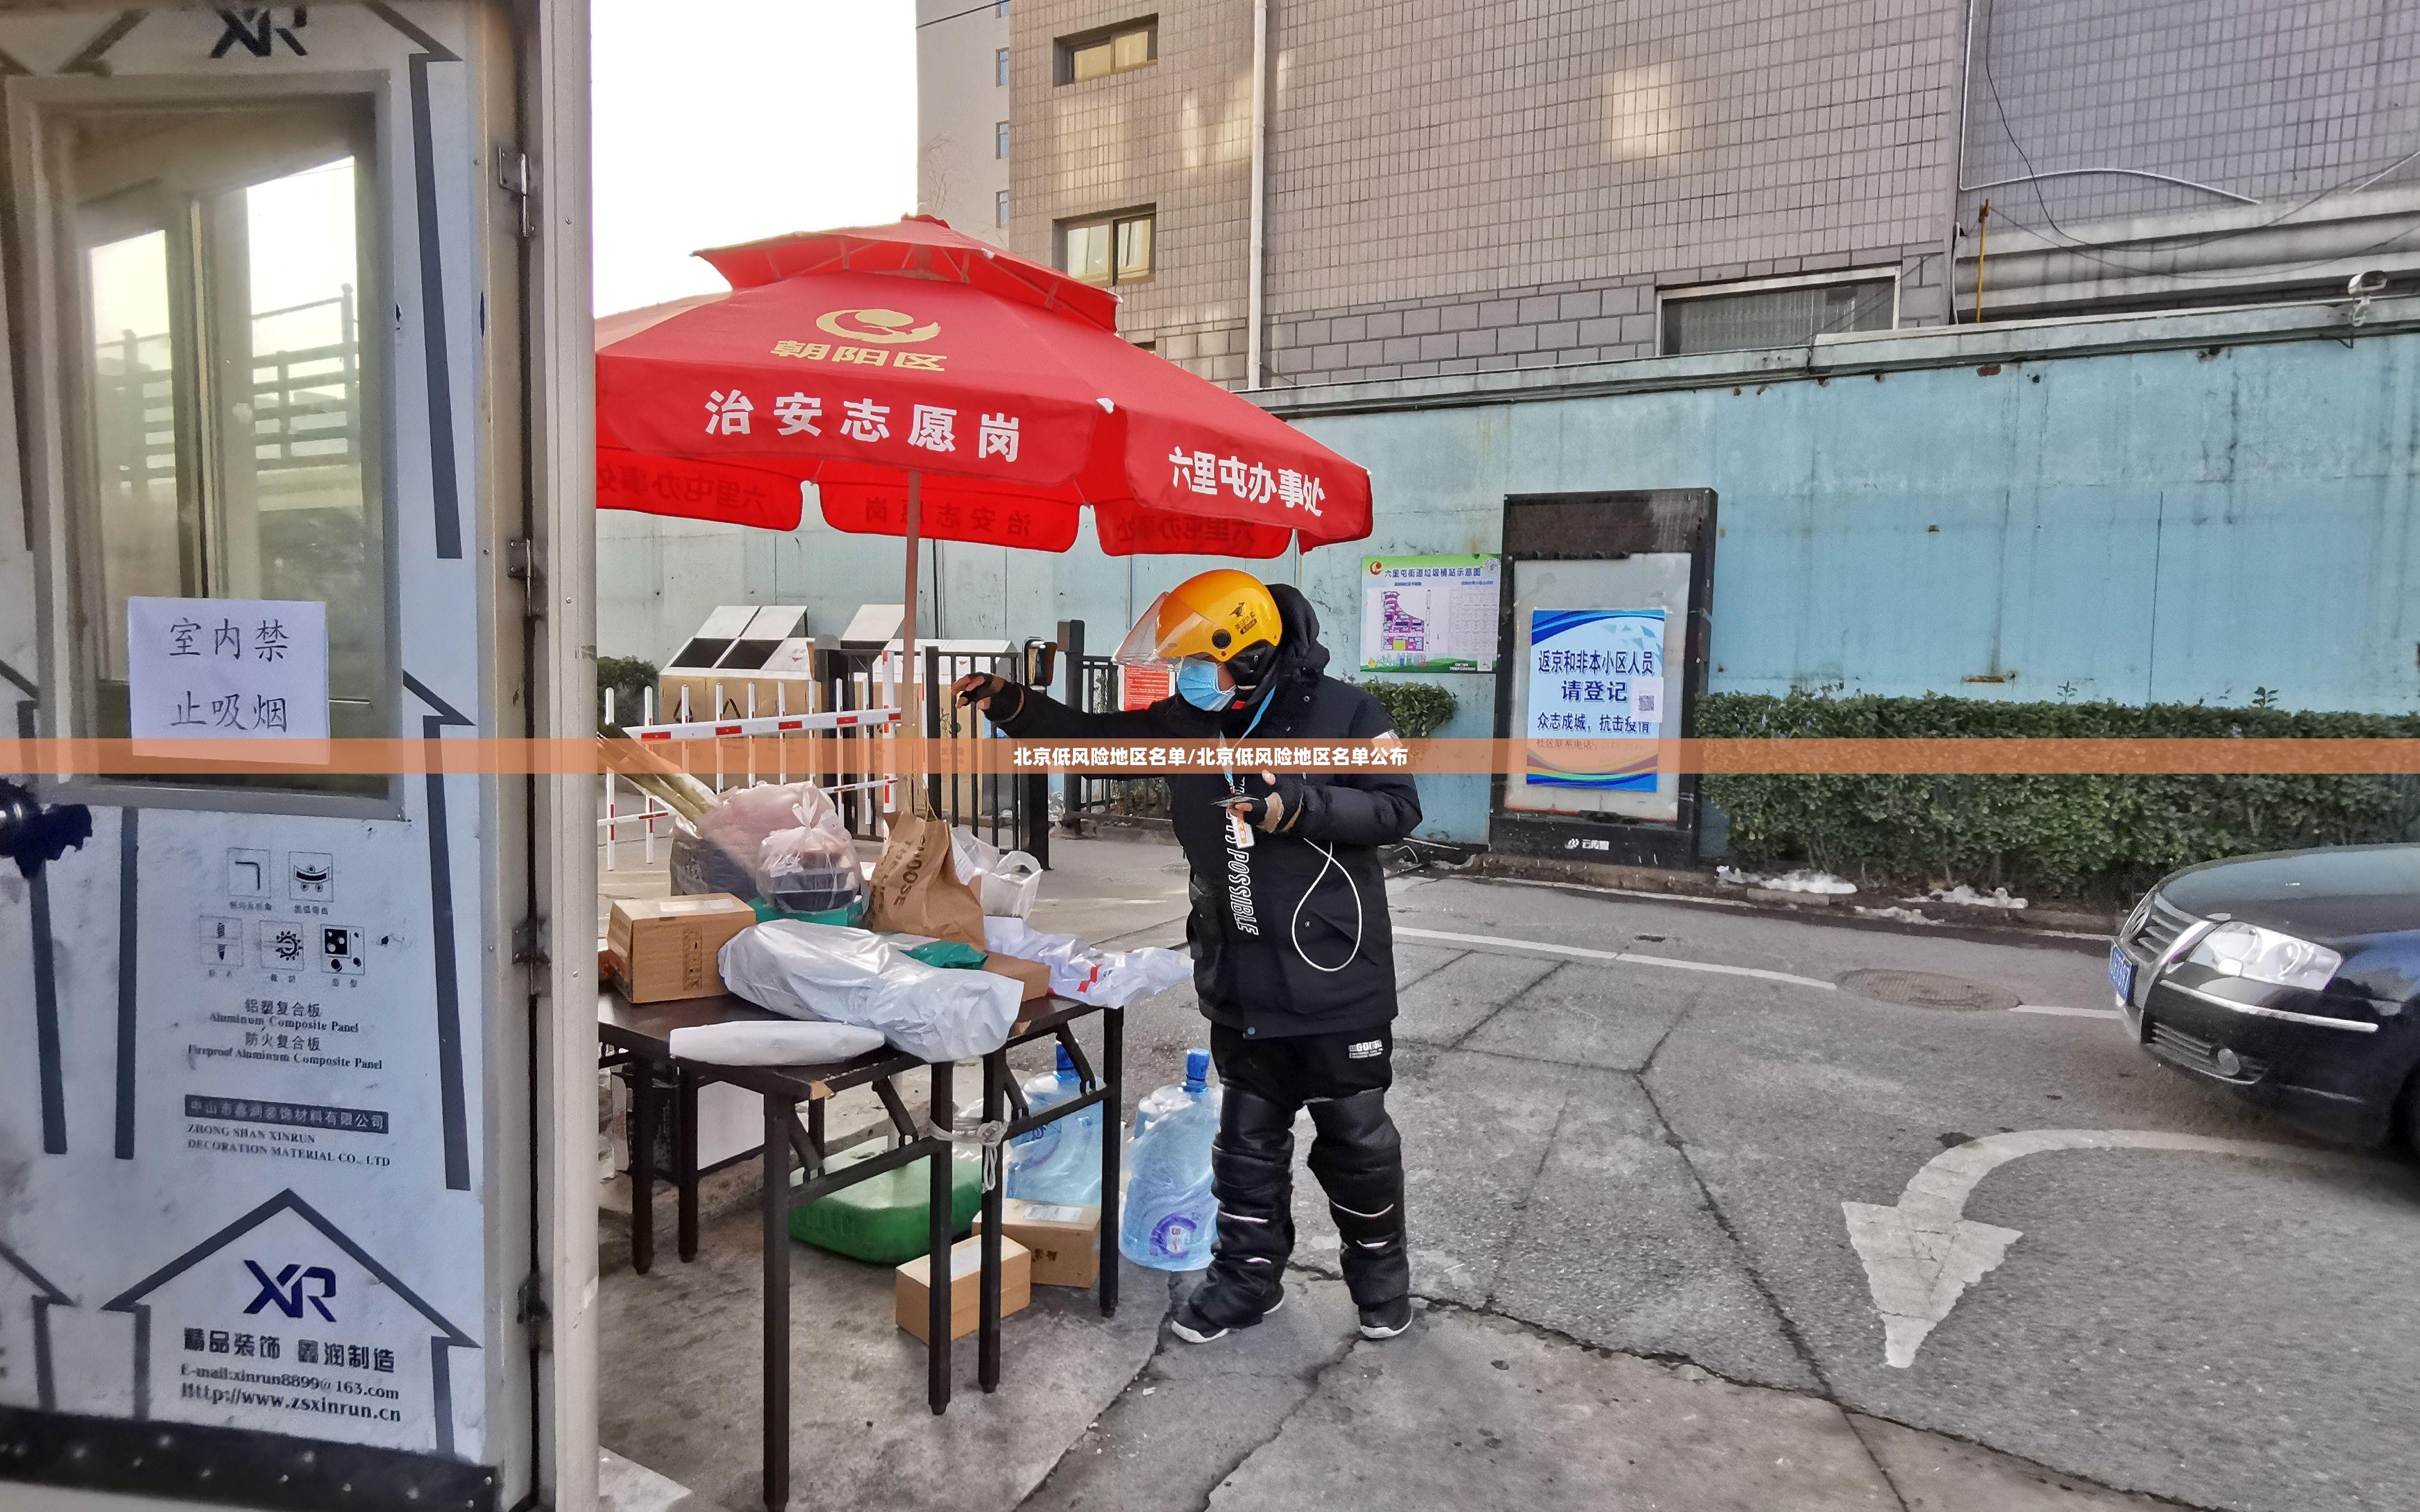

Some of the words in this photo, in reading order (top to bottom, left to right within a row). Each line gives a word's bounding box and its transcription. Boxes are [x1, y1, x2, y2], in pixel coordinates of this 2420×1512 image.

[770, 340, 948, 371] 朝阳区
[704, 389, 1020, 462] 治安志愿岗
[1168, 446, 1325, 517] 六里屯办事处
[170, 617, 289, 662] 室内禁
[1538, 650, 1655, 675] 返京和非本小区人员
[1561, 680, 1627, 702] 请登记
[170, 690, 288, 733] 止吸烟
[1227, 847, 1259, 935] POSSIBLE
[245, 998, 322, 1018] 铝塑复合板
[269, 1015, 327, 1031] Composite
[331, 1021, 358, 1033] Panel
[245, 1031, 321, 1051] 防火复合板
[236, 1048, 289, 1062] Aluminum
[294, 1053, 350, 1067] Composite
[354, 1058, 382, 1070] Panel
[233, 1127, 265, 1139] SHAN
[188, 1139, 267, 1154] DECORATION
[271, 1146, 335, 1161] MATERIAL
[243, 1260, 337, 1322] XR
